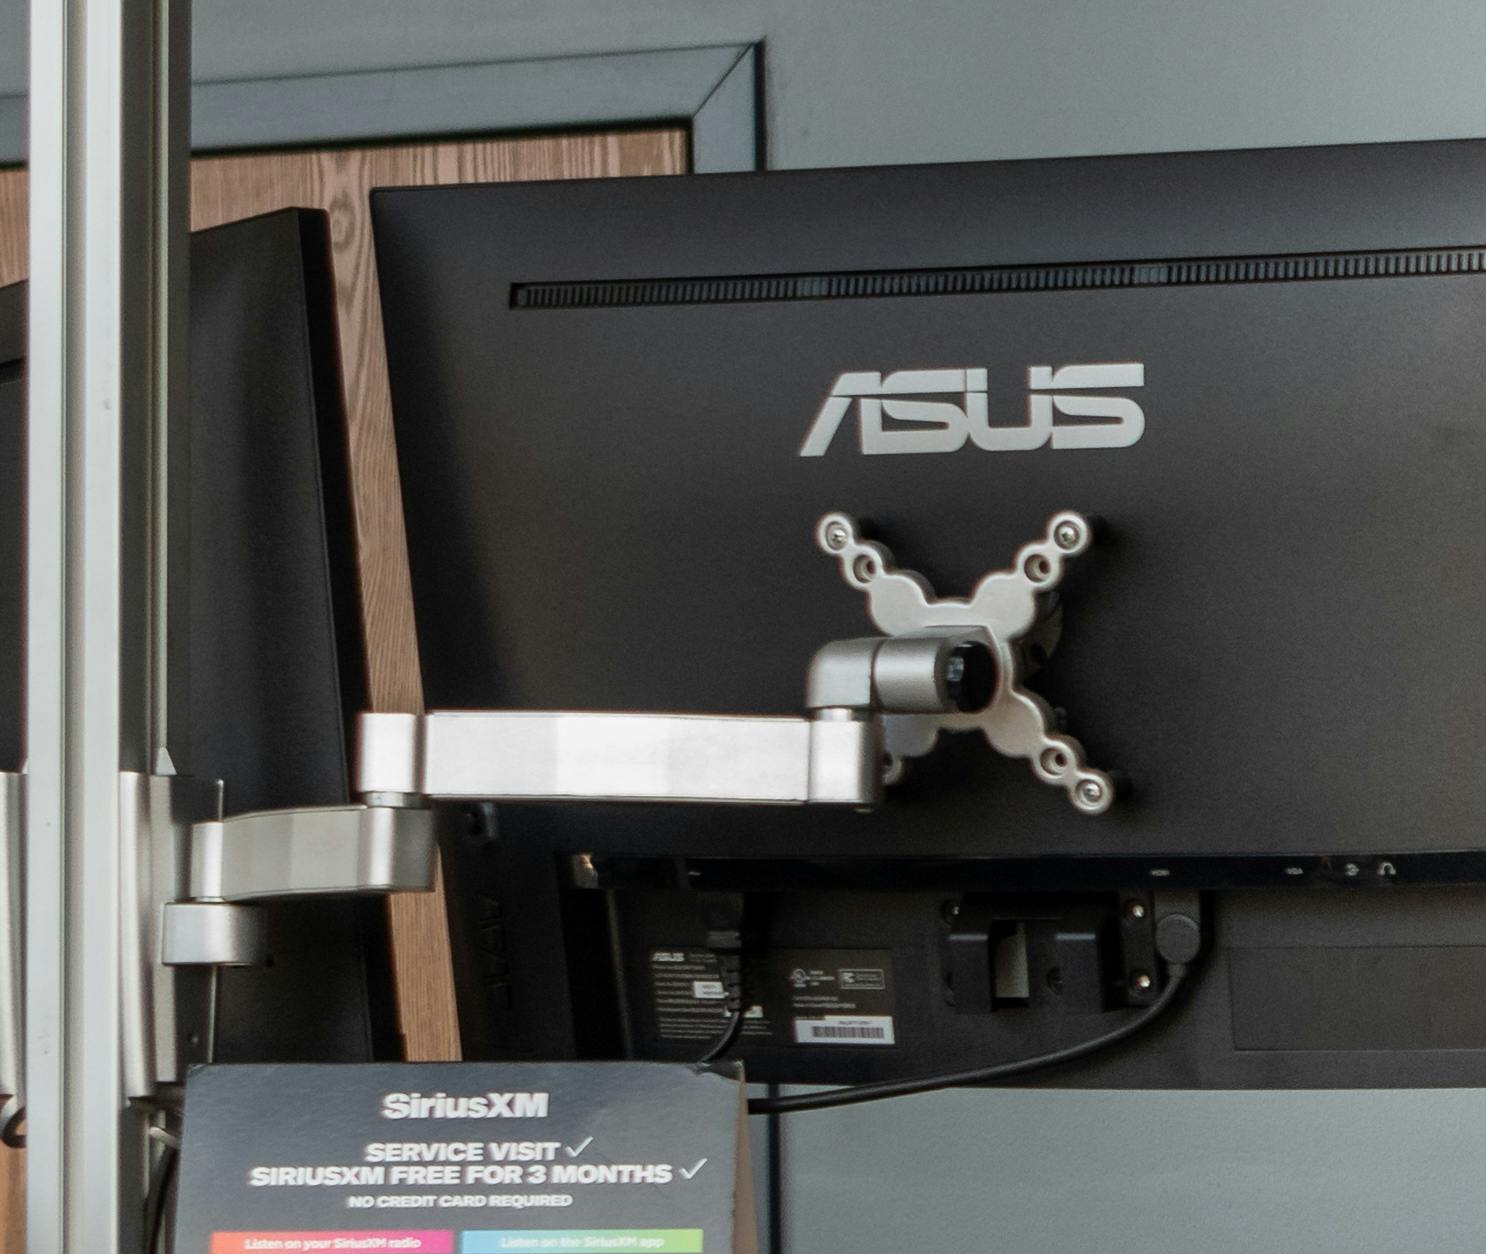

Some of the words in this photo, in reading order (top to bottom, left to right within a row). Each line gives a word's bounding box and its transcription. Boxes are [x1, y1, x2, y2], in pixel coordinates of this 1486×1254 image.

[799, 363, 1145, 457] ASUS
[381, 1091, 550, 1119] SiriusXM
[364, 1141, 484, 1162] SERVICE
[490, 1140, 562, 1161] VISIT
[249, 1165, 384, 1187] SIRIUSXM
[391, 1165, 463, 1185] FREE
[467, 1165, 523, 1184] FOR
[526, 1165, 547, 1184] 3
[551, 1163, 673, 1184] MONTHS
[347, 1195, 374, 1208] NO
[375, 1195, 437, 1208] CREDIT
[441, 1194, 487, 1207] CARD
[489, 1193, 573, 1208] REQUIRED
[244, 1238, 283, 1250] Listen
[285, 1239, 301, 1249] on
[303, 1239, 332, 1251] your
[334, 1238, 387, 1249] SiriusXM
[389, 1238, 421, 1248] radio
[500, 1237, 539, 1248] Listen
[541, 1238, 558, 1248] on
[559, 1236, 582, 1247] the
[583, 1236, 637, 1248] SiriusXM
[639, 1237, 665, 1249] app
